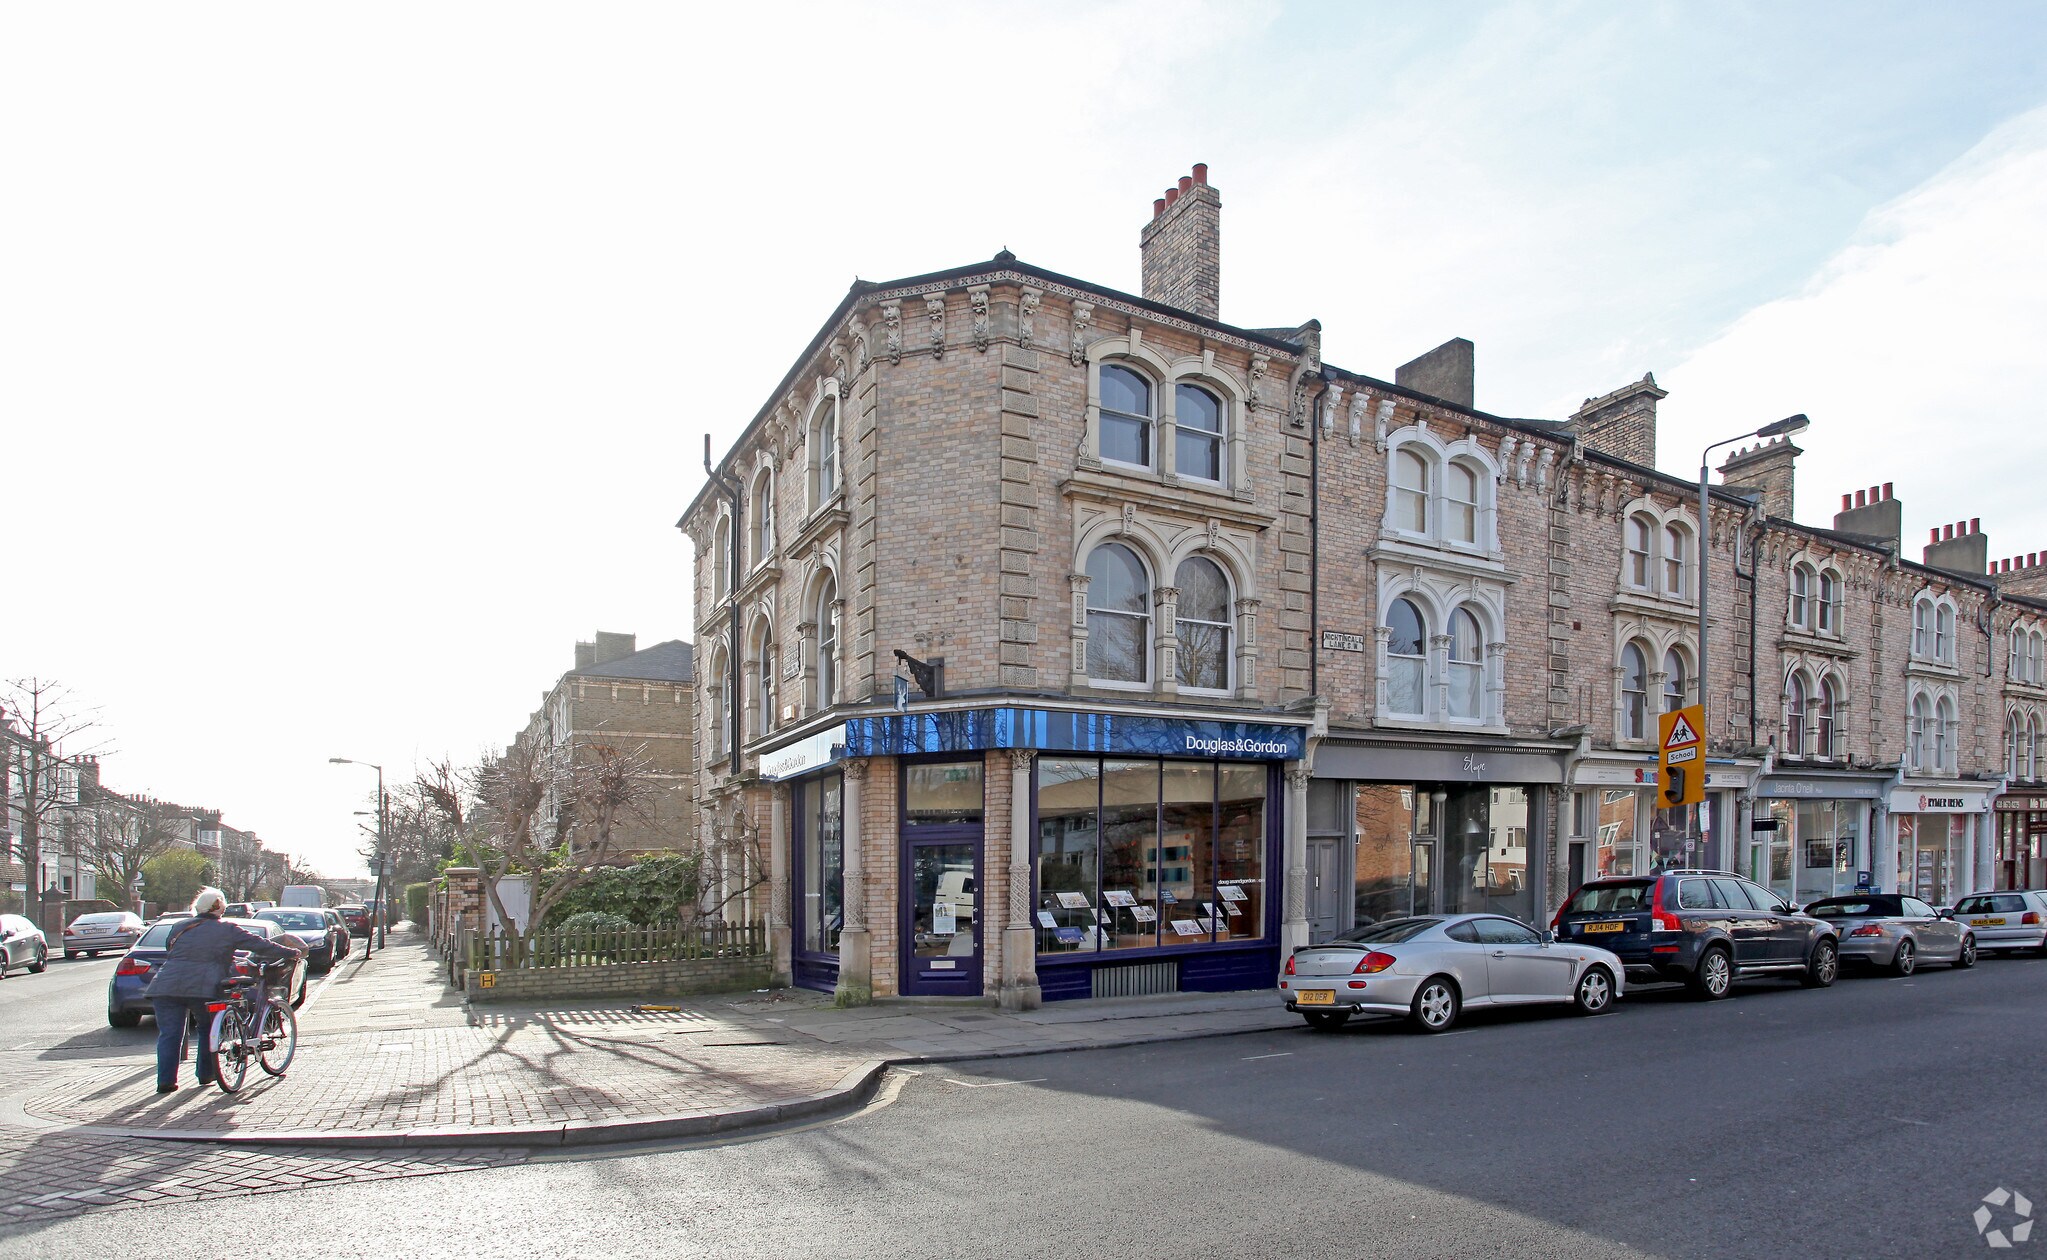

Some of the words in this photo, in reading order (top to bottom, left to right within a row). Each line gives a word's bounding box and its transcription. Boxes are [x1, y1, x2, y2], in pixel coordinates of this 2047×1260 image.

[1324, 633, 1362, 643] NIGHTINGALE
[1330, 641, 1345, 649] LANE
[1186, 736, 1287, 754] Douglas&Gordon
[1670, 750, 1694, 761] School
[1859, 873, 1869, 883] P
[482, 975, 493, 987] H
